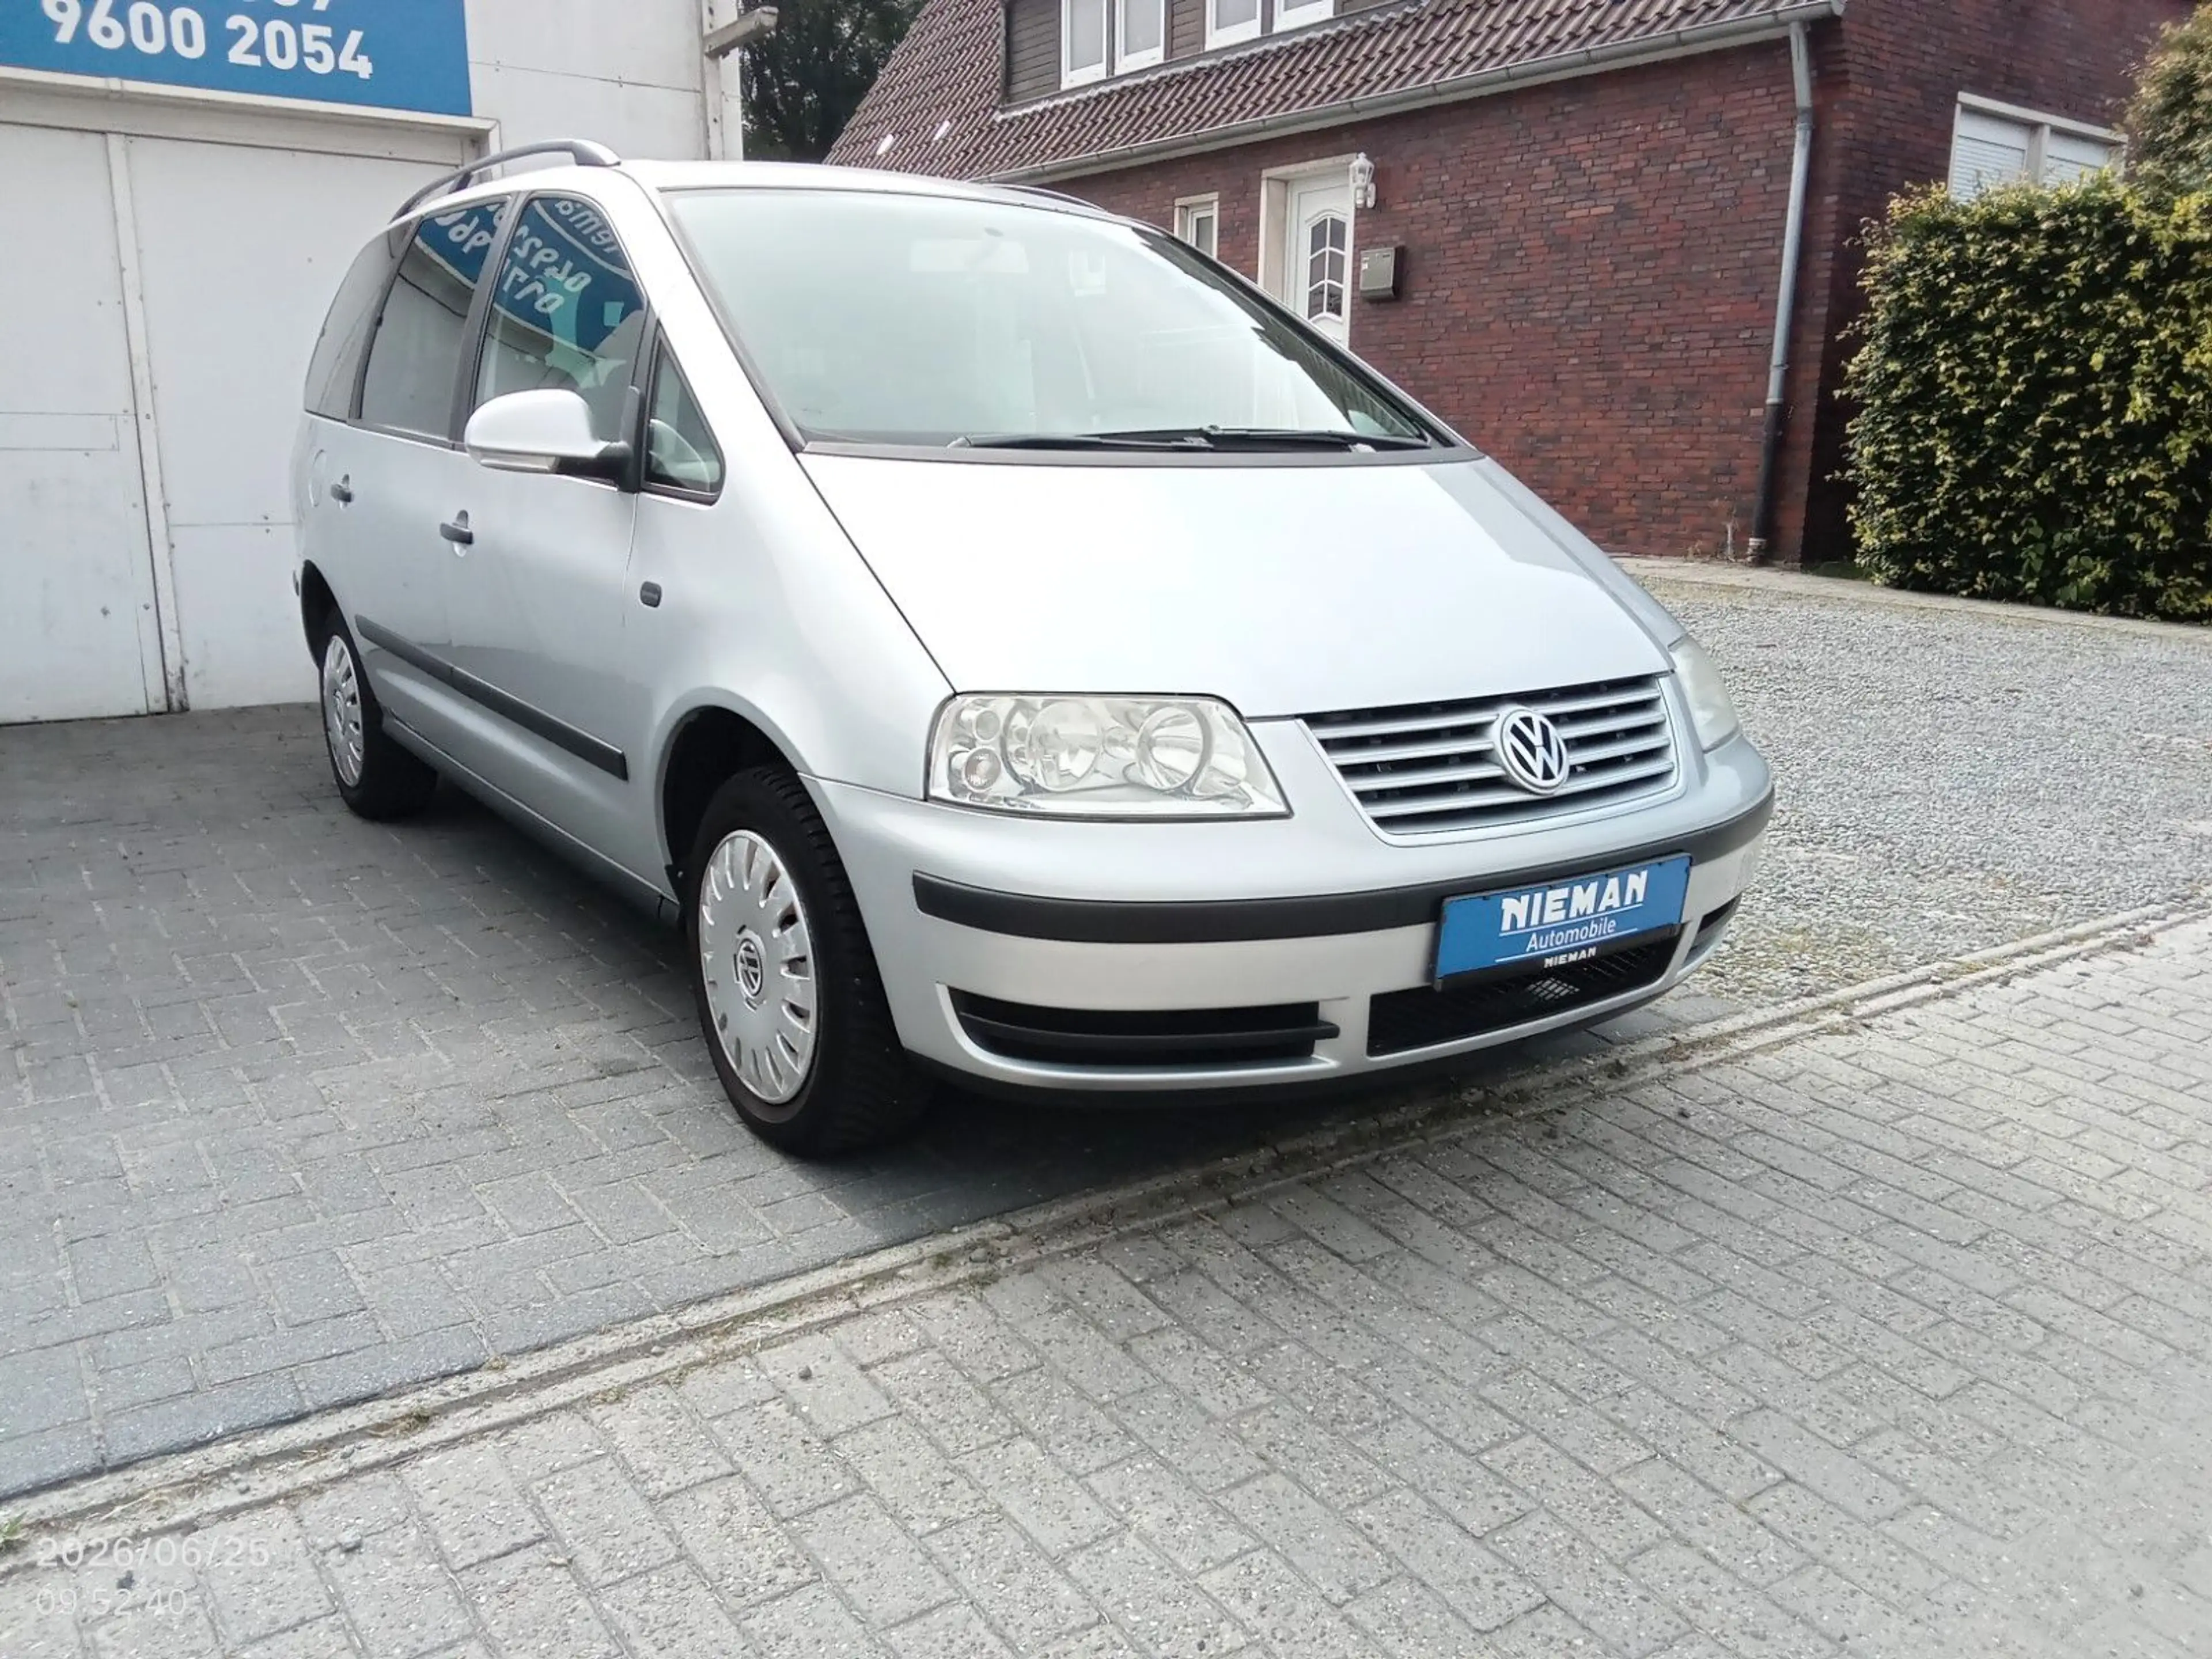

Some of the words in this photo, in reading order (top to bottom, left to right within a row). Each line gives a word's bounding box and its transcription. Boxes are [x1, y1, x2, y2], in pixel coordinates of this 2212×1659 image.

[43, 0, 206, 59] 9600
[225, 14, 373, 79] 2054
[1501, 870, 1647, 931] NIEMAN
[1526, 918, 1616, 952] Automobile
[1544, 946, 1597, 968] NIEMAN
